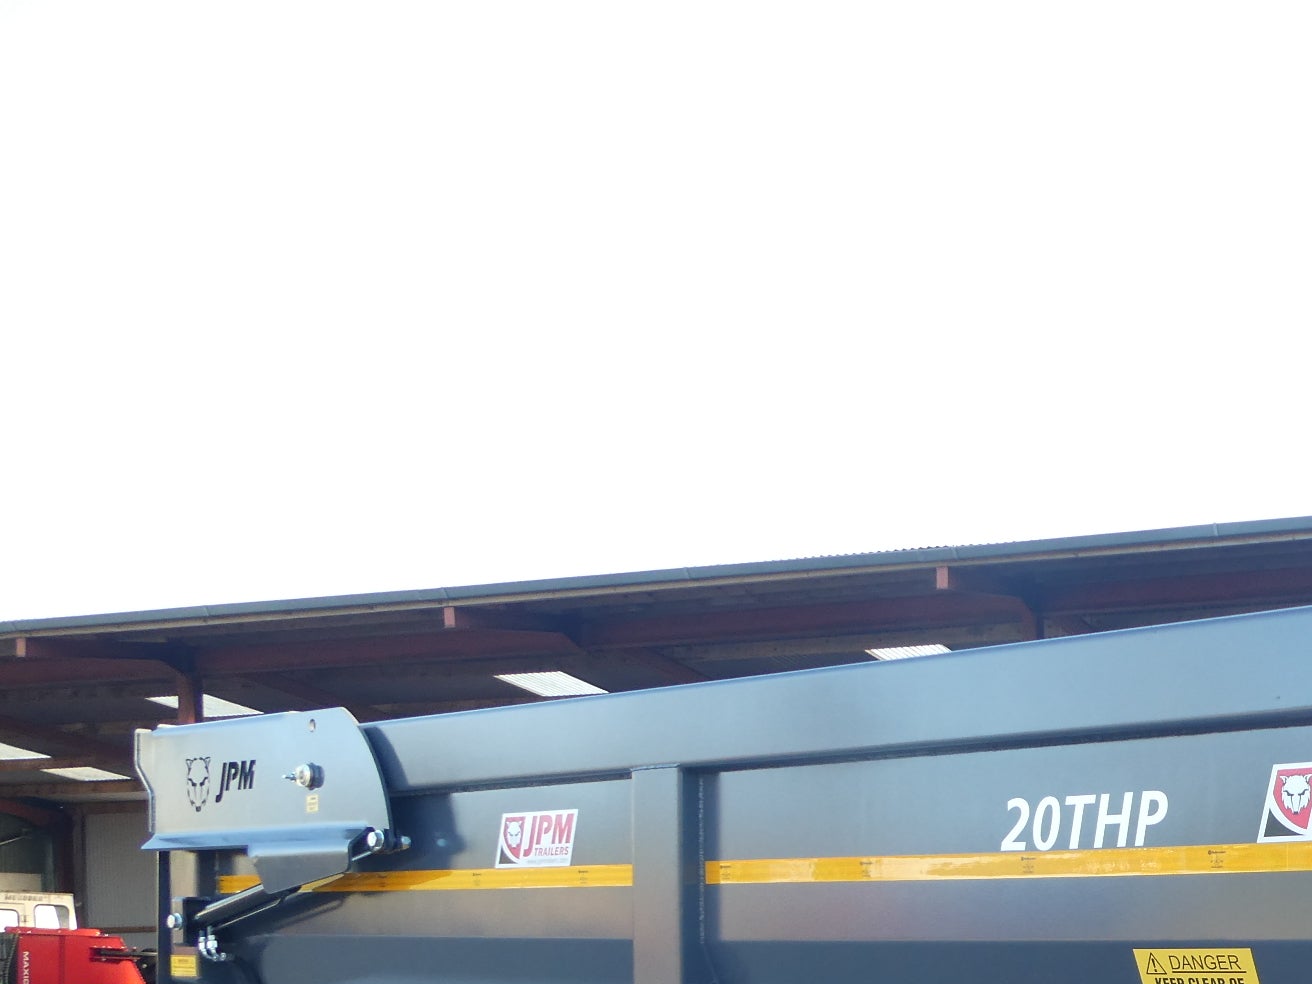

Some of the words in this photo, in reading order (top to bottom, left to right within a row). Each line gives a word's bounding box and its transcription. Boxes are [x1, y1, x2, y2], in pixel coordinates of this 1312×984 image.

[215, 759, 257, 803] JPM
[523, 813, 575, 857] JPM
[1000, 790, 1169, 852] 20THP
[534, 846, 569, 856] TRAILERS
[1168, 955, 1242, 970] DANGER
